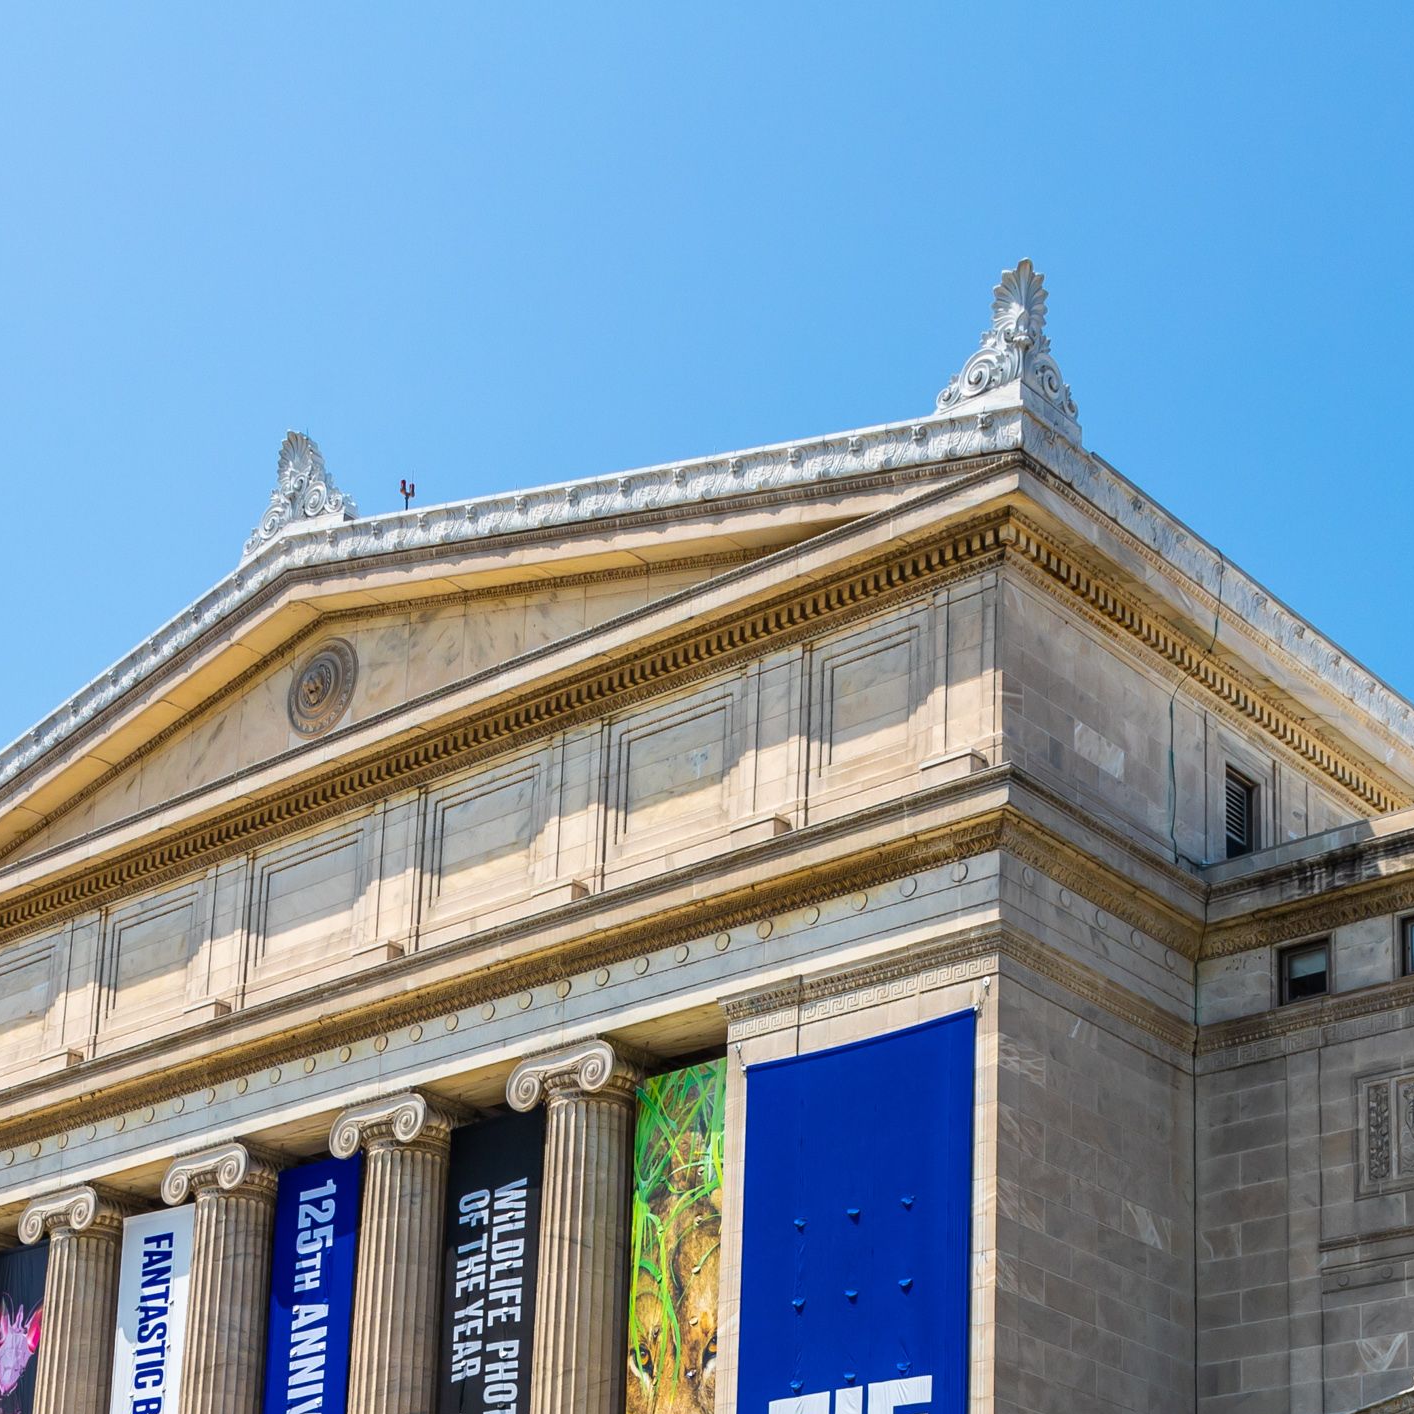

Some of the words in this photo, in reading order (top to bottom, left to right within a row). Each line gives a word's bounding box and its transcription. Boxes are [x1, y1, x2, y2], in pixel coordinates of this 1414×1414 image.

[293, 1178, 337, 1293] 125TH
[458, 1189, 491, 1227] OF
[487, 1177, 528, 1327] WILDLIFE
[134, 1232, 174, 1390] FANTASTIC
[455, 1233, 488, 1298] THE
[451, 1298, 485, 1384] YEAR
